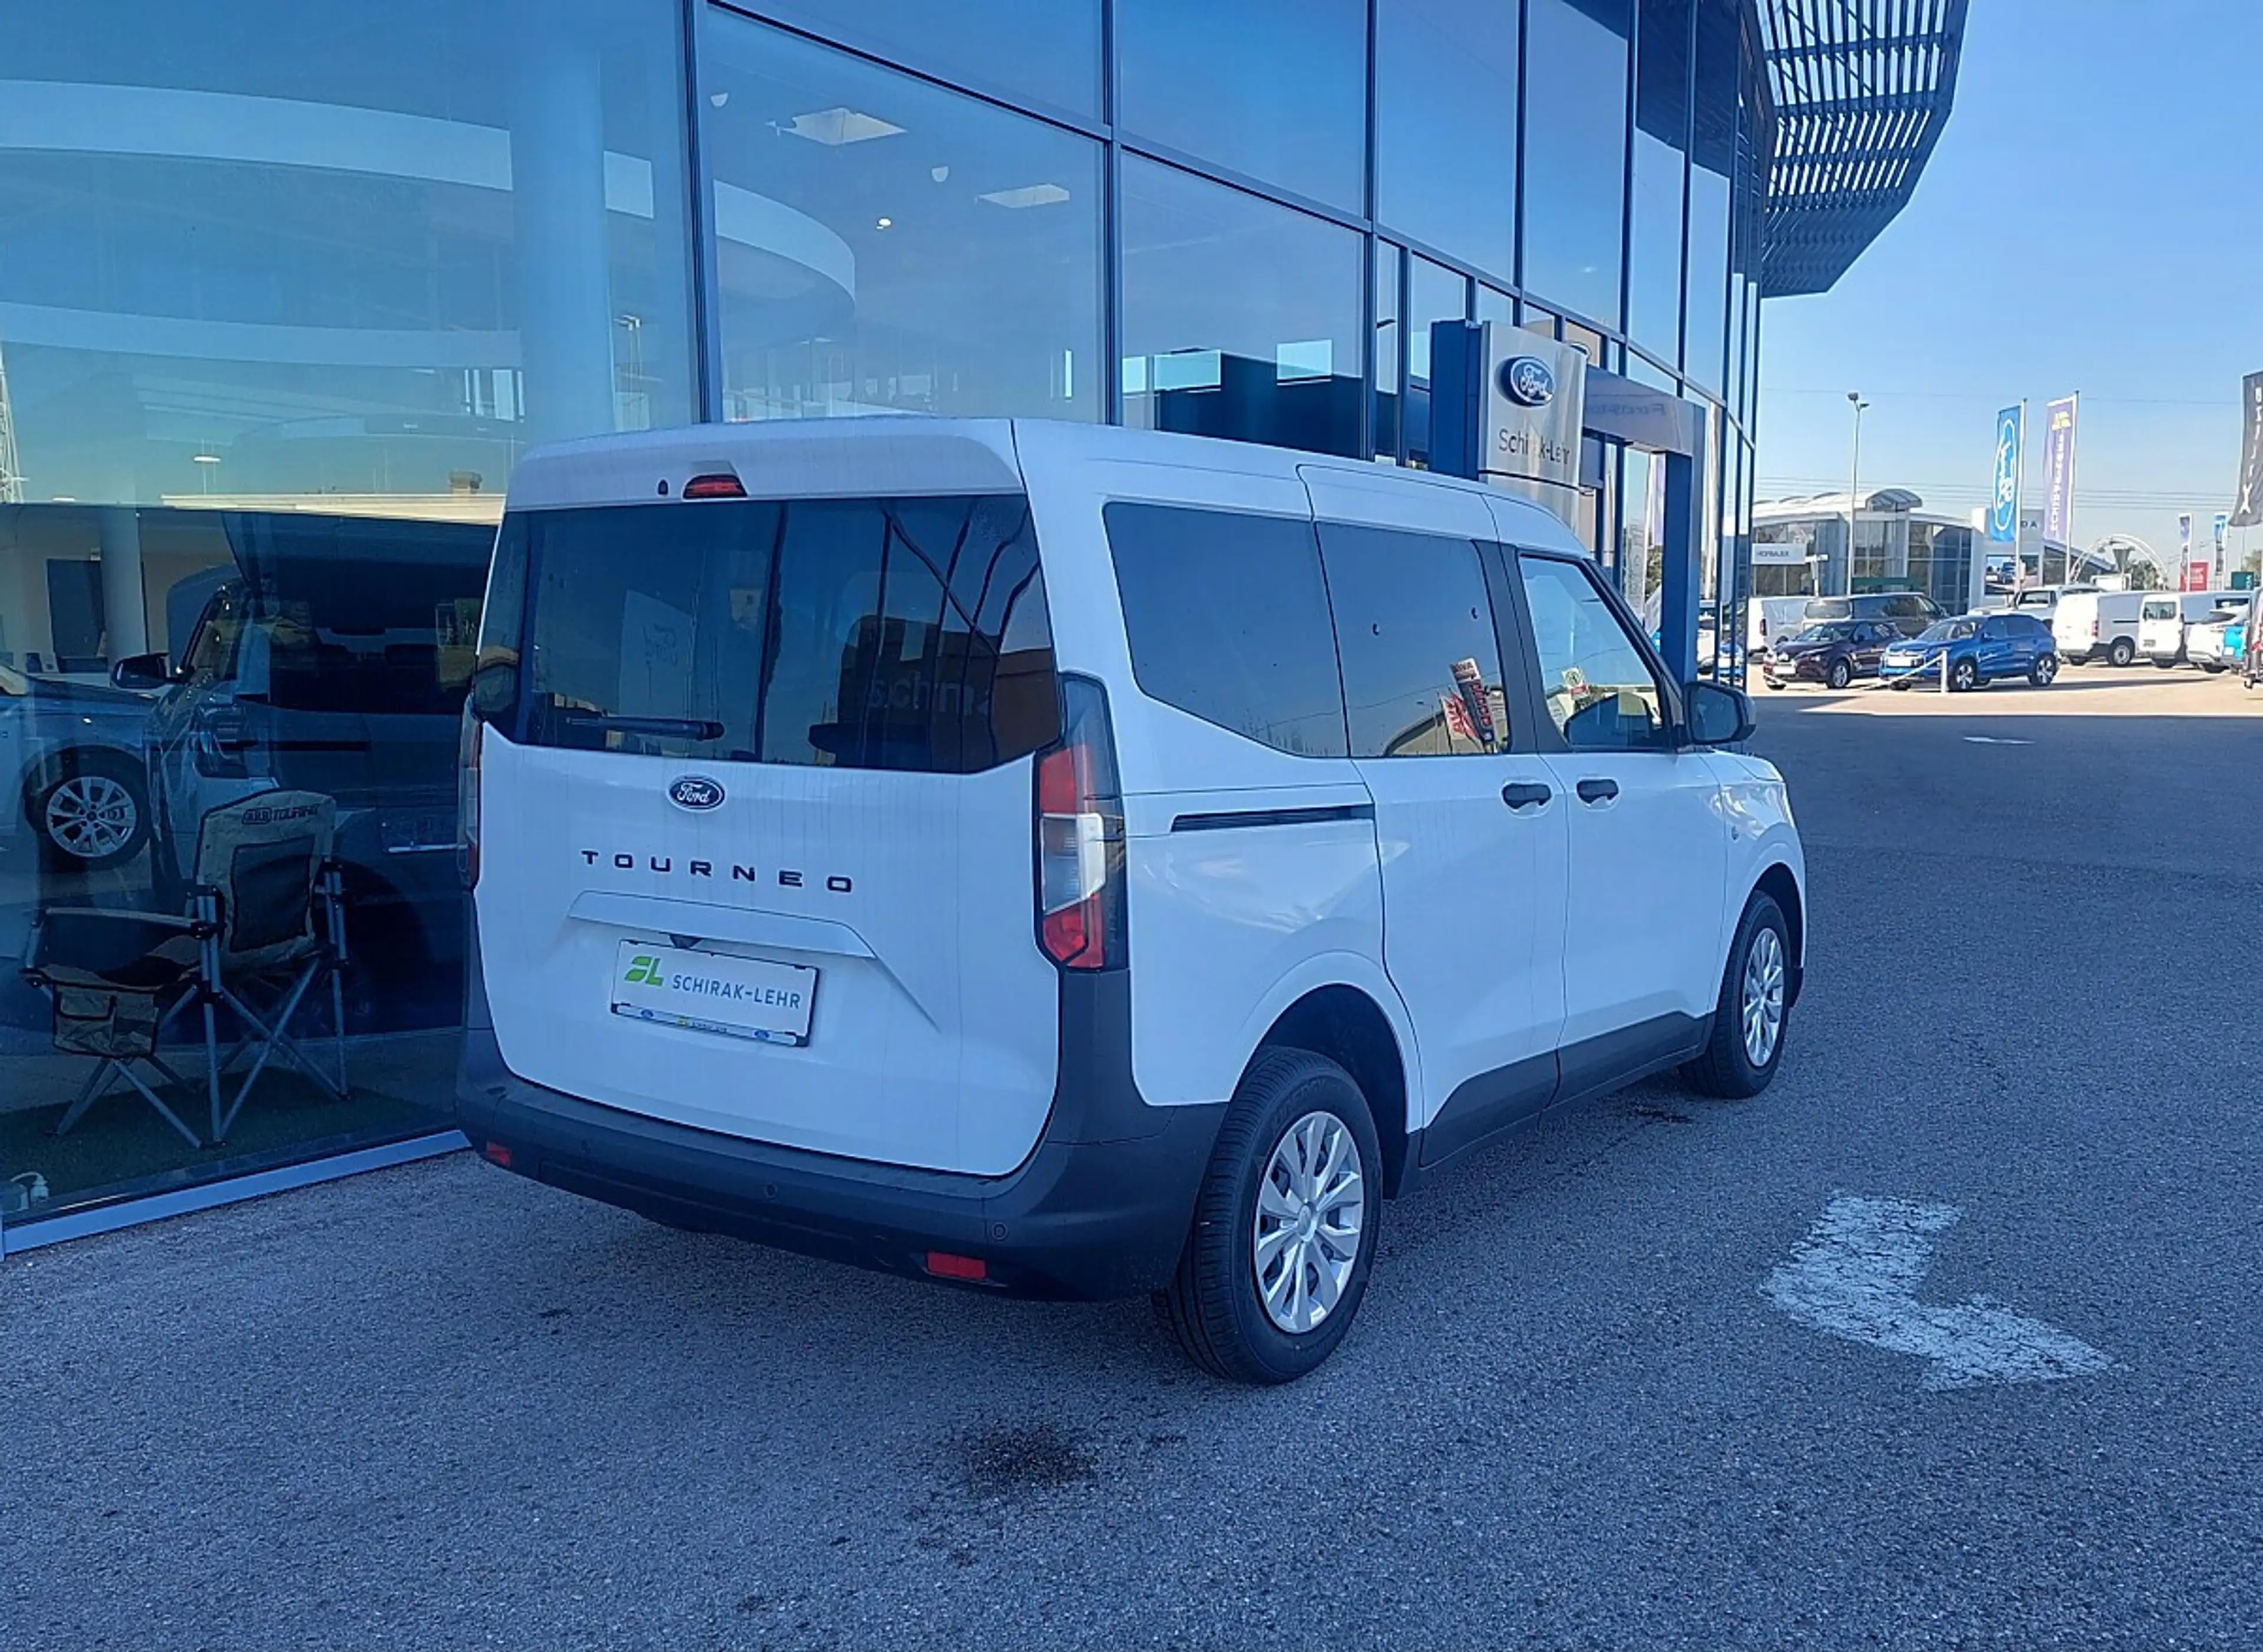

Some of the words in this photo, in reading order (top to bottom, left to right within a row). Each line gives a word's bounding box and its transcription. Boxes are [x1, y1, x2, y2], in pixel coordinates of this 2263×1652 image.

[677, 782, 711, 804] Ford
[580, 849, 852, 893] TOURNEO
[672, 974, 801, 1010] SCHIRAK-LEHR
